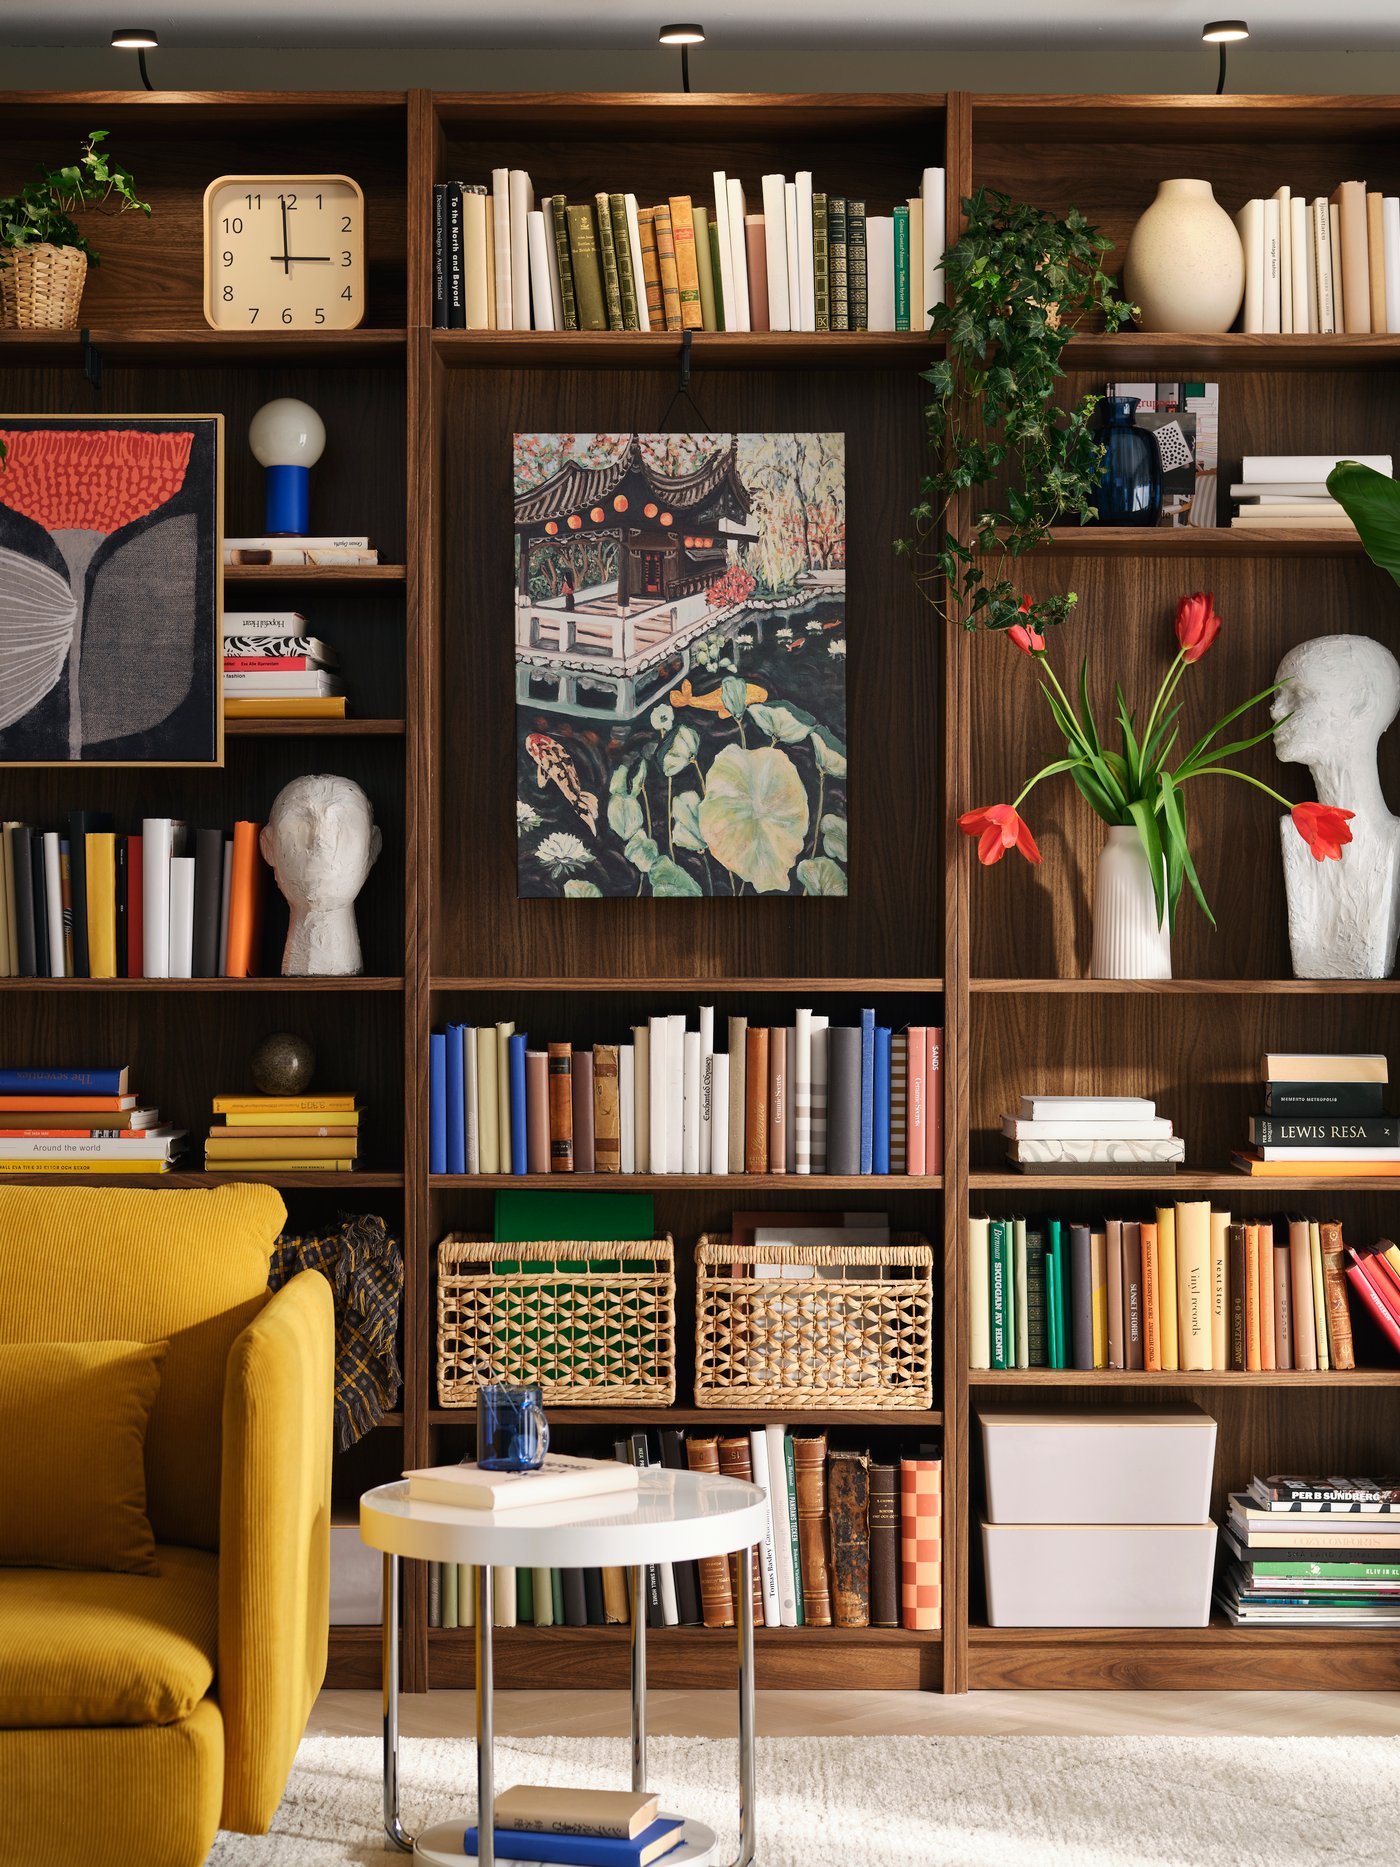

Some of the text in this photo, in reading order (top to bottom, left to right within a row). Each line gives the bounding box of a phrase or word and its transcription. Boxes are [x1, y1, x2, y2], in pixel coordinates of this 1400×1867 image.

[245, 194, 262, 210] 11
[277, 194, 299, 210] 12
[315, 194, 323, 210] 1
[222, 218, 243, 234] 10
[341, 216, 353, 233] 2
[222, 251, 234, 268] 9
[340, 251, 353, 268] 3
[435, 248, 442, 256] by
[451, 196, 460, 307] To the North and Beyond
[222, 285, 234, 302] 8
[340, 285, 354, 302] 4
[248, 308, 260, 325] 7
[281, 308, 293, 325] 6
[314, 308, 326, 325] 5
[242, 619, 285, 629] Hopeful Heart
[703, 1056, 713, 1121] Enchanted Odyssey
[774, 1097, 782, 1123] Ceramic
[1280, 1126, 1368, 1139] LEWIS RESA
[33, 1144, 102, 1152] Around the world
[994, 1262, 1003, 1310] SKUGGAN
[1188, 1267, 1202, 1337] Vinyl records
[1215, 1287, 1223, 1317] Story
[994, 1311, 1003, 1326] AV
[1130, 1283, 1139, 1342] SUNSET STORIES
[995, 1327, 1004, 1363] HENRY
[1291, 1492, 1381, 1501] PER B SUNDBERG
[768, 1573, 776, 1598] Tomas
